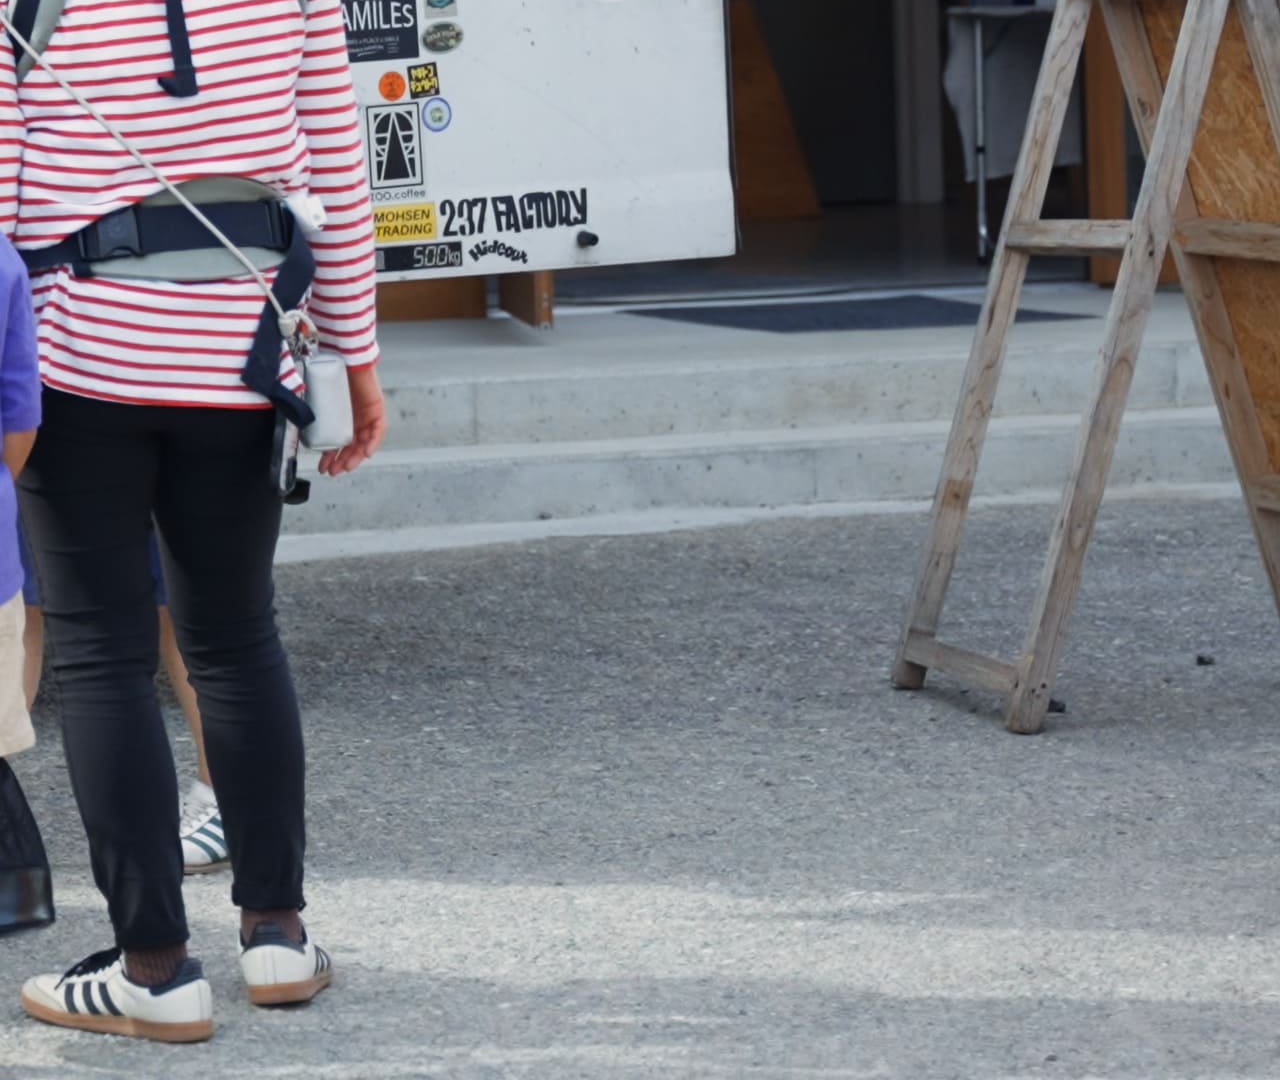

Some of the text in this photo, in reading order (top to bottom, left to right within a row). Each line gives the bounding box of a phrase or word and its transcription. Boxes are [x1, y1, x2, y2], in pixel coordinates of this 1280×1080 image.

[374, 208, 431, 222] MOHSEN
[440, 187, 588, 237] 237 FACTORY
[376, 222, 433, 238] TRADING
